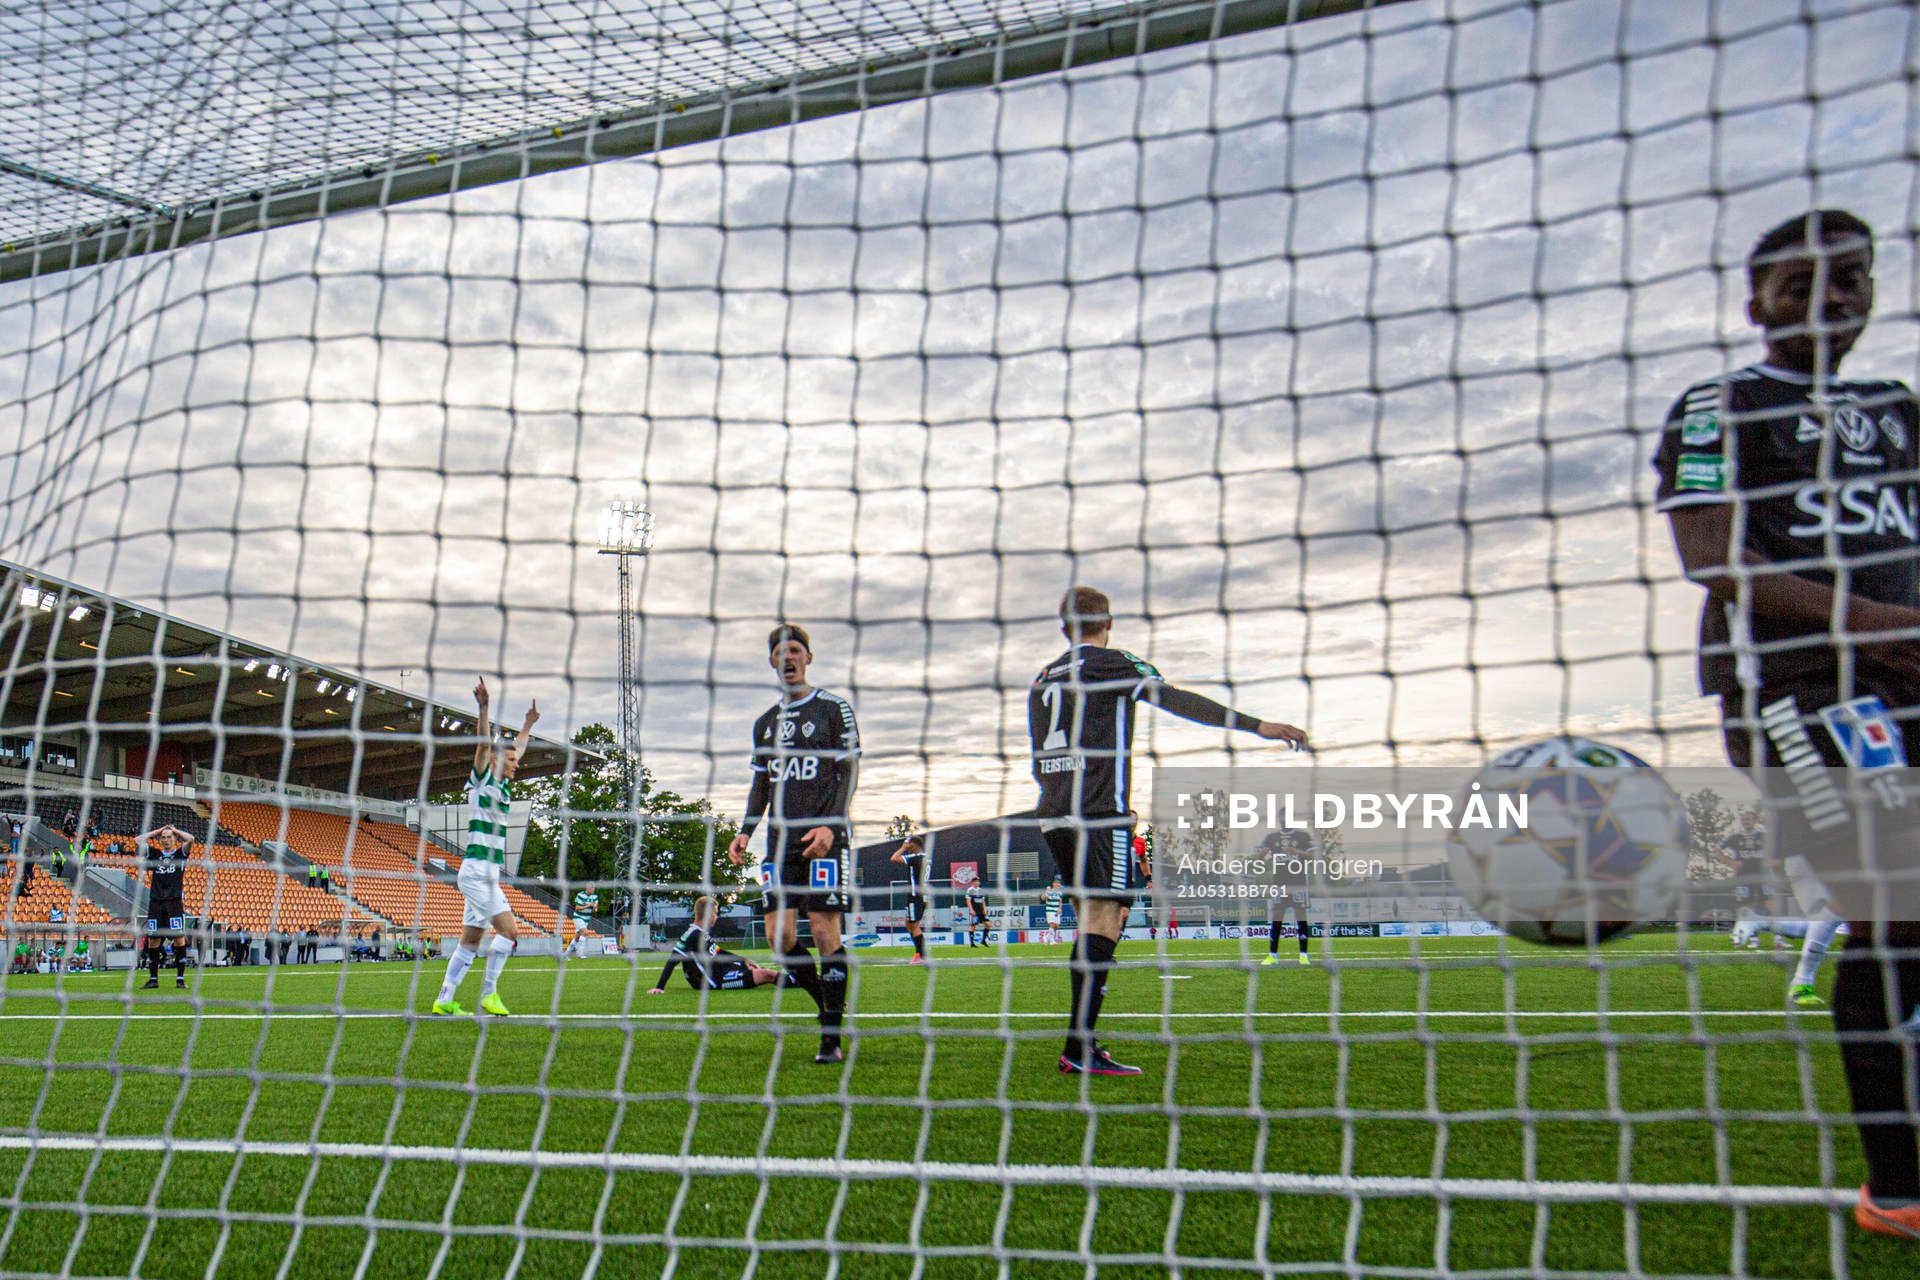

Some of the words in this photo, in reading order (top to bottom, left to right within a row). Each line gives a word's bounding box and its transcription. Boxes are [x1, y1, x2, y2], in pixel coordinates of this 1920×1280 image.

[1788, 480, 1918, 541] SSA
[768, 755, 819, 782] SAB
[1344, 926, 1357, 936] the
